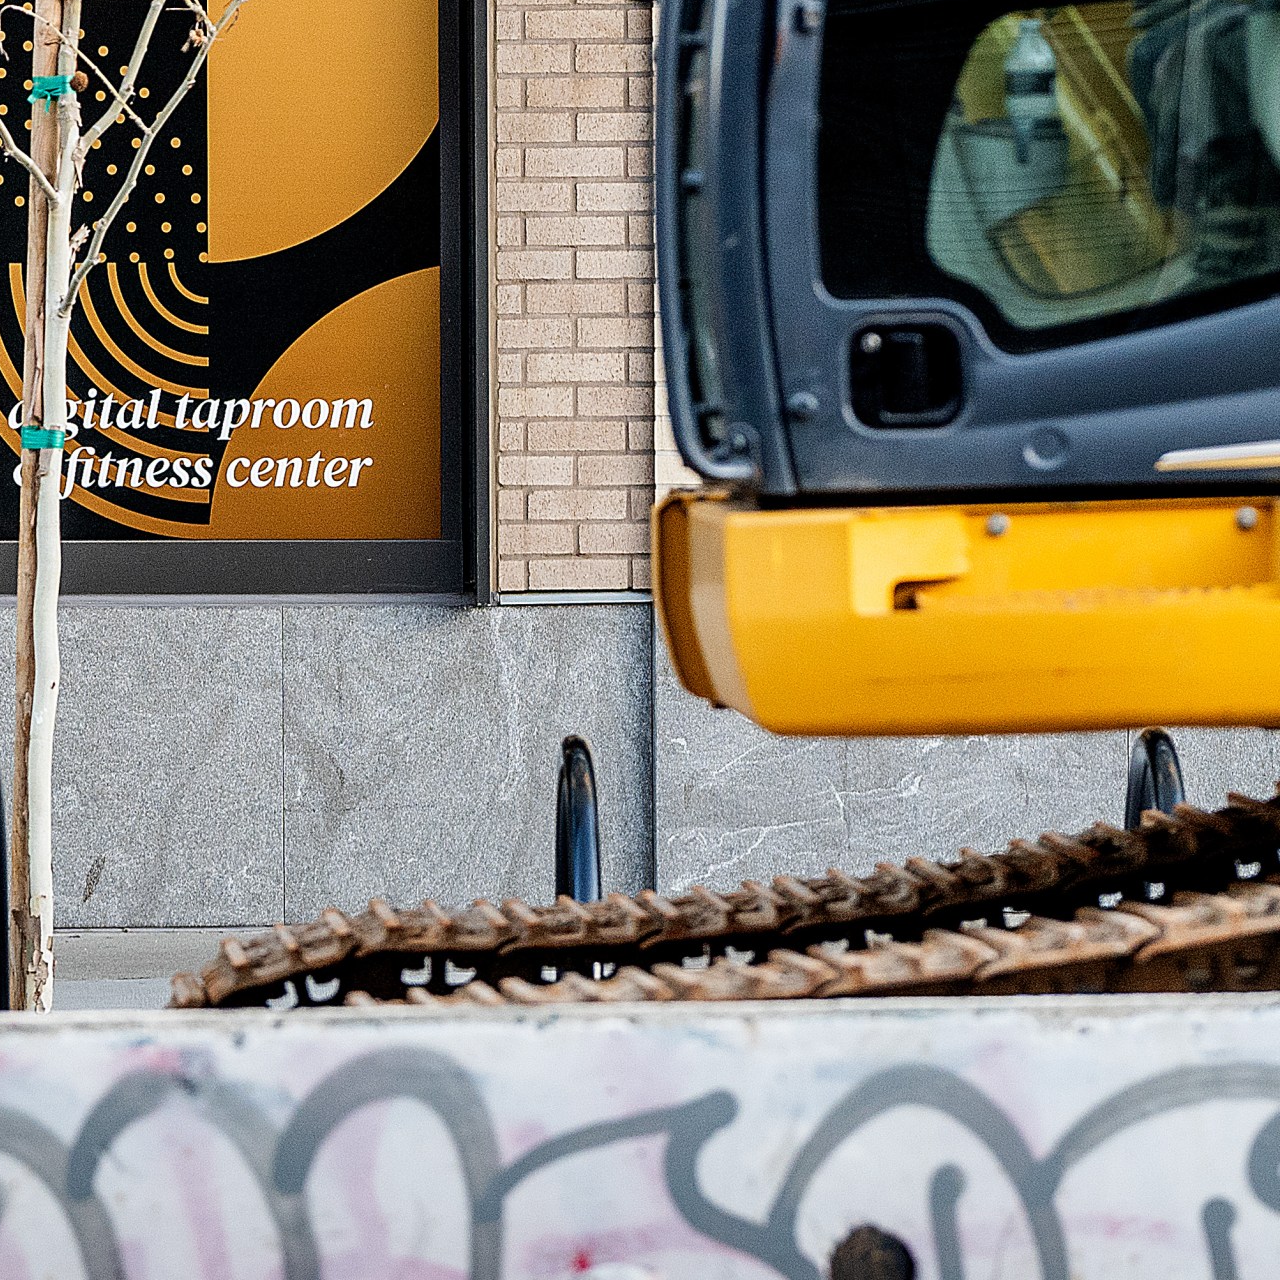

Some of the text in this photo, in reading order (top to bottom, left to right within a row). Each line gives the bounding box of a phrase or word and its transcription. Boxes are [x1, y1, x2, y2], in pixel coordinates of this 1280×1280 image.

[174, 391, 375, 441] taproom
[58, 446, 214, 500] fitness
[225, 449, 373, 489] center
